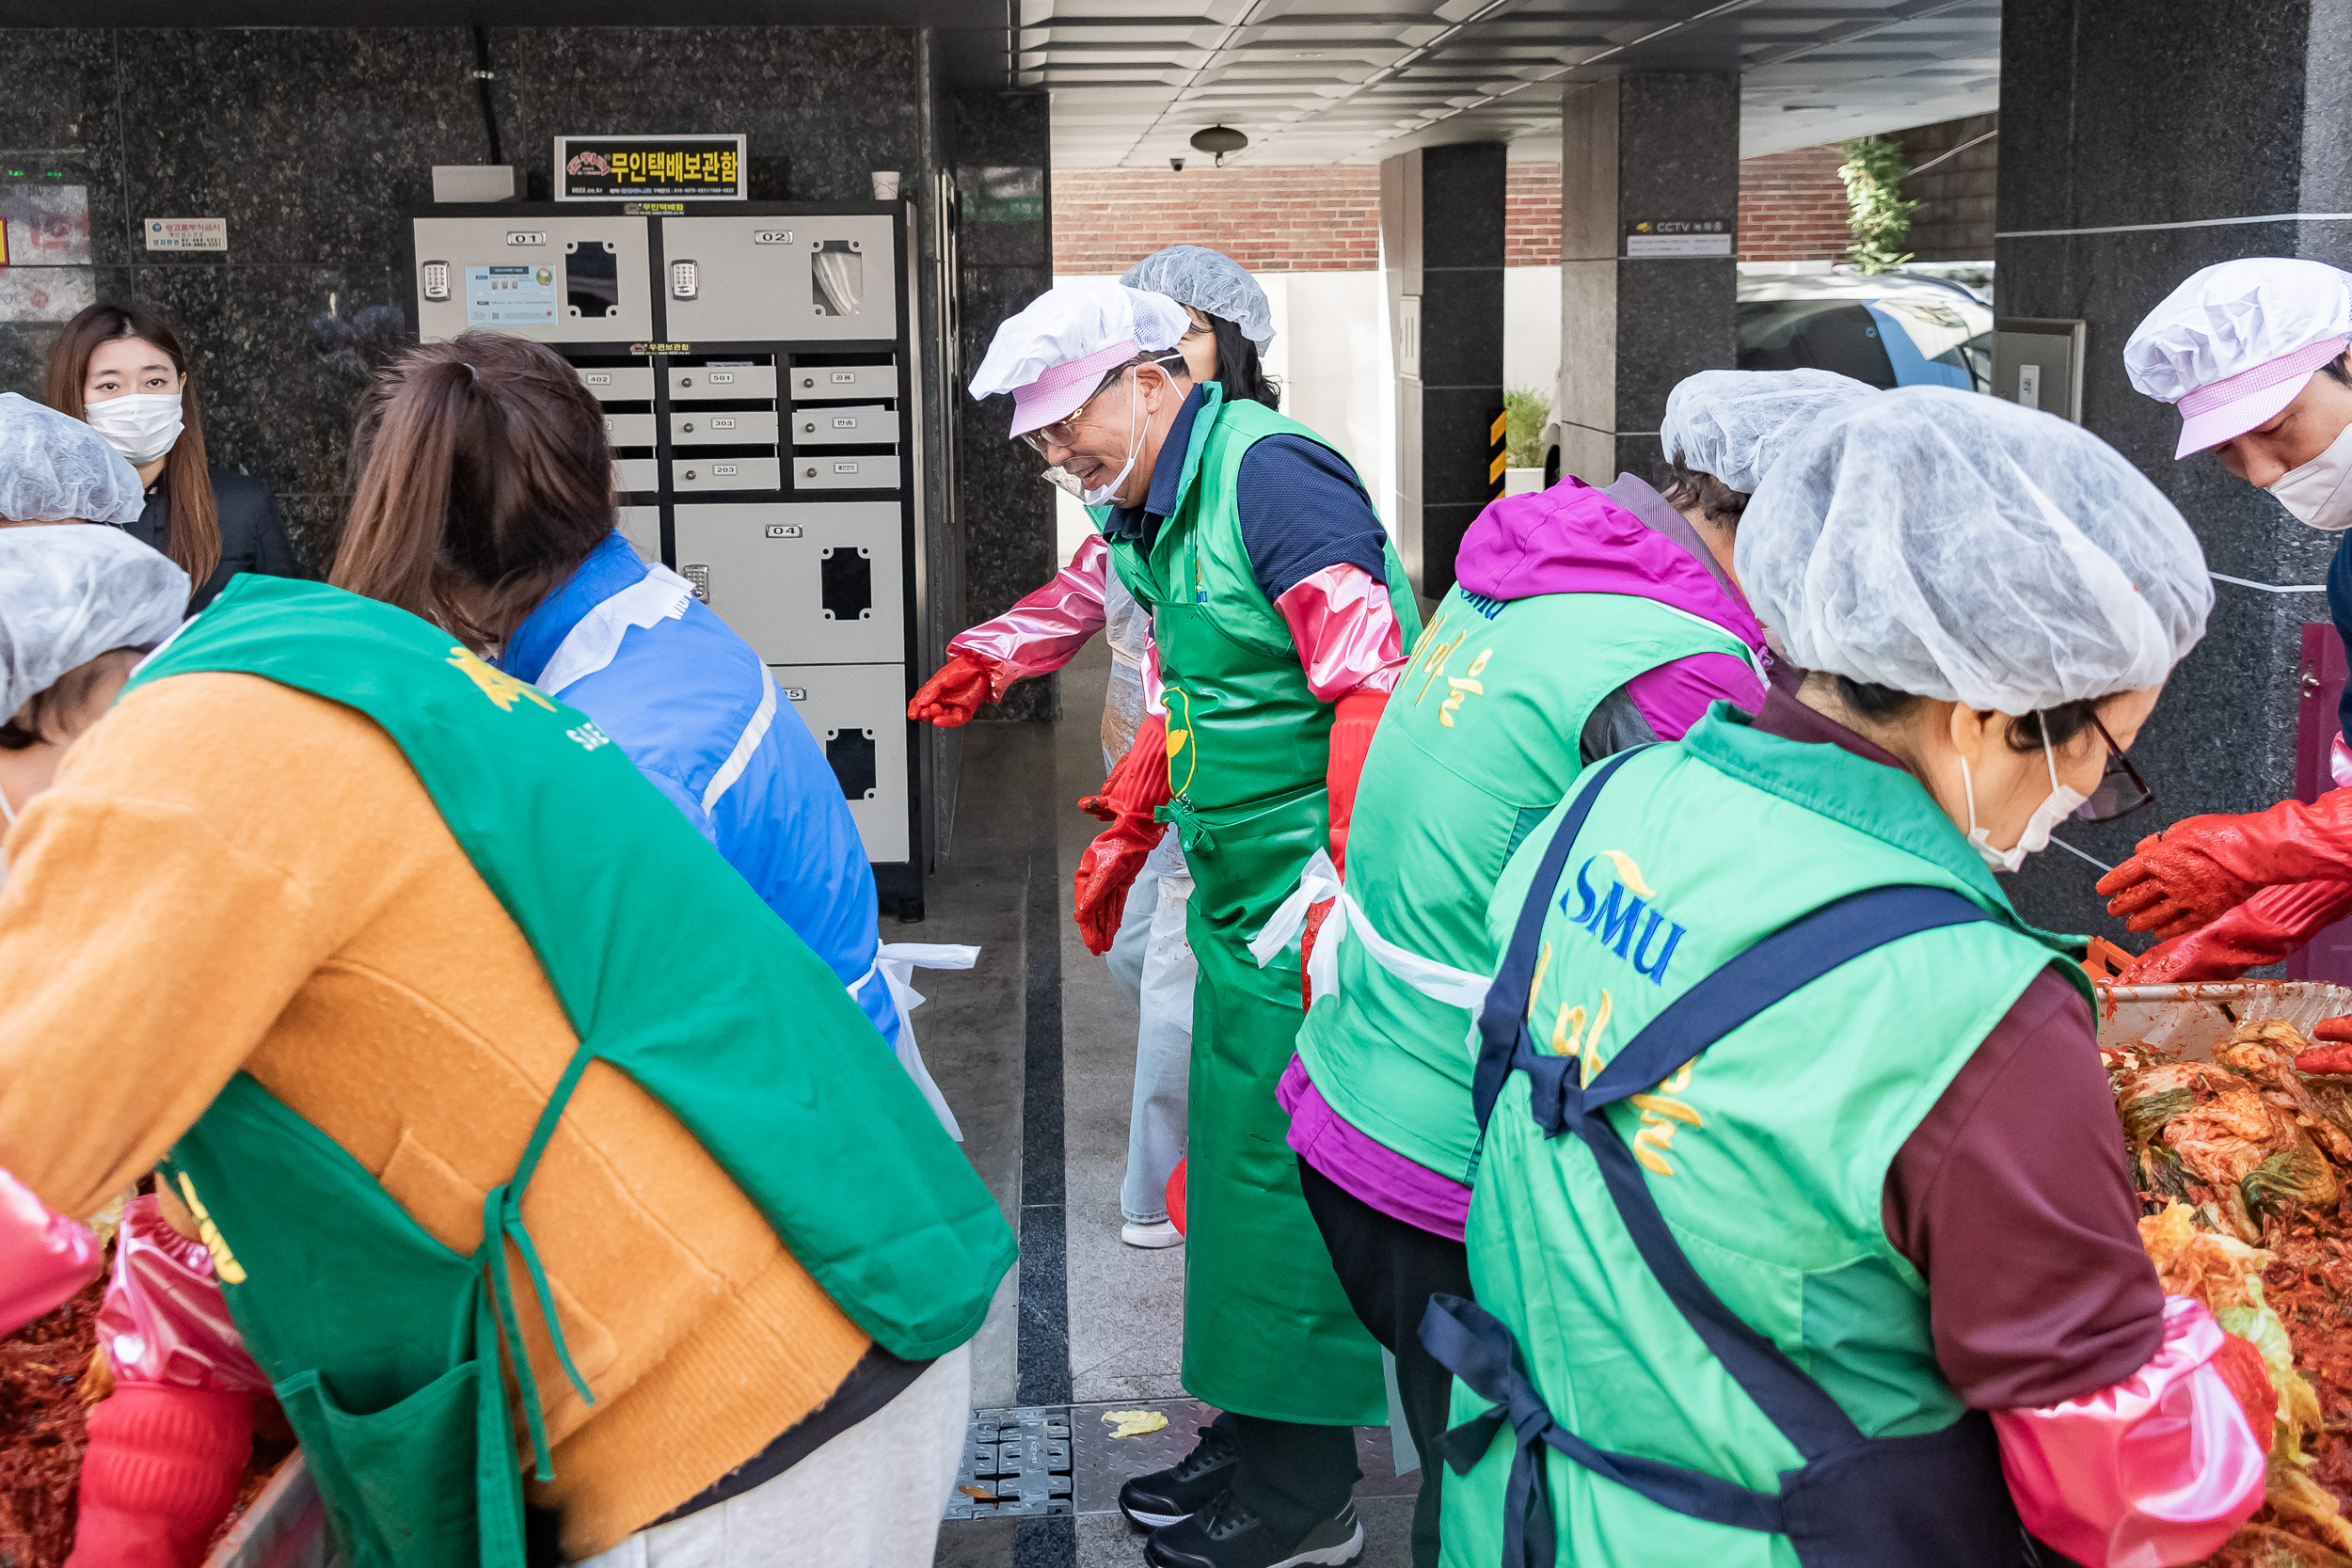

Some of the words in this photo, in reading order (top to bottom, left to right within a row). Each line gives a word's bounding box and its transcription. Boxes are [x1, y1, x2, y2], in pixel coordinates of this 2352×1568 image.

[612, 151, 738, 183] 무인택배보관함
[1657, 222, 1691, 232] CCTV
[515, 234, 536, 244] 01
[762, 232, 786, 242] 02
[772, 527, 796, 535] 04
[1558, 854, 1688, 987] SMU
